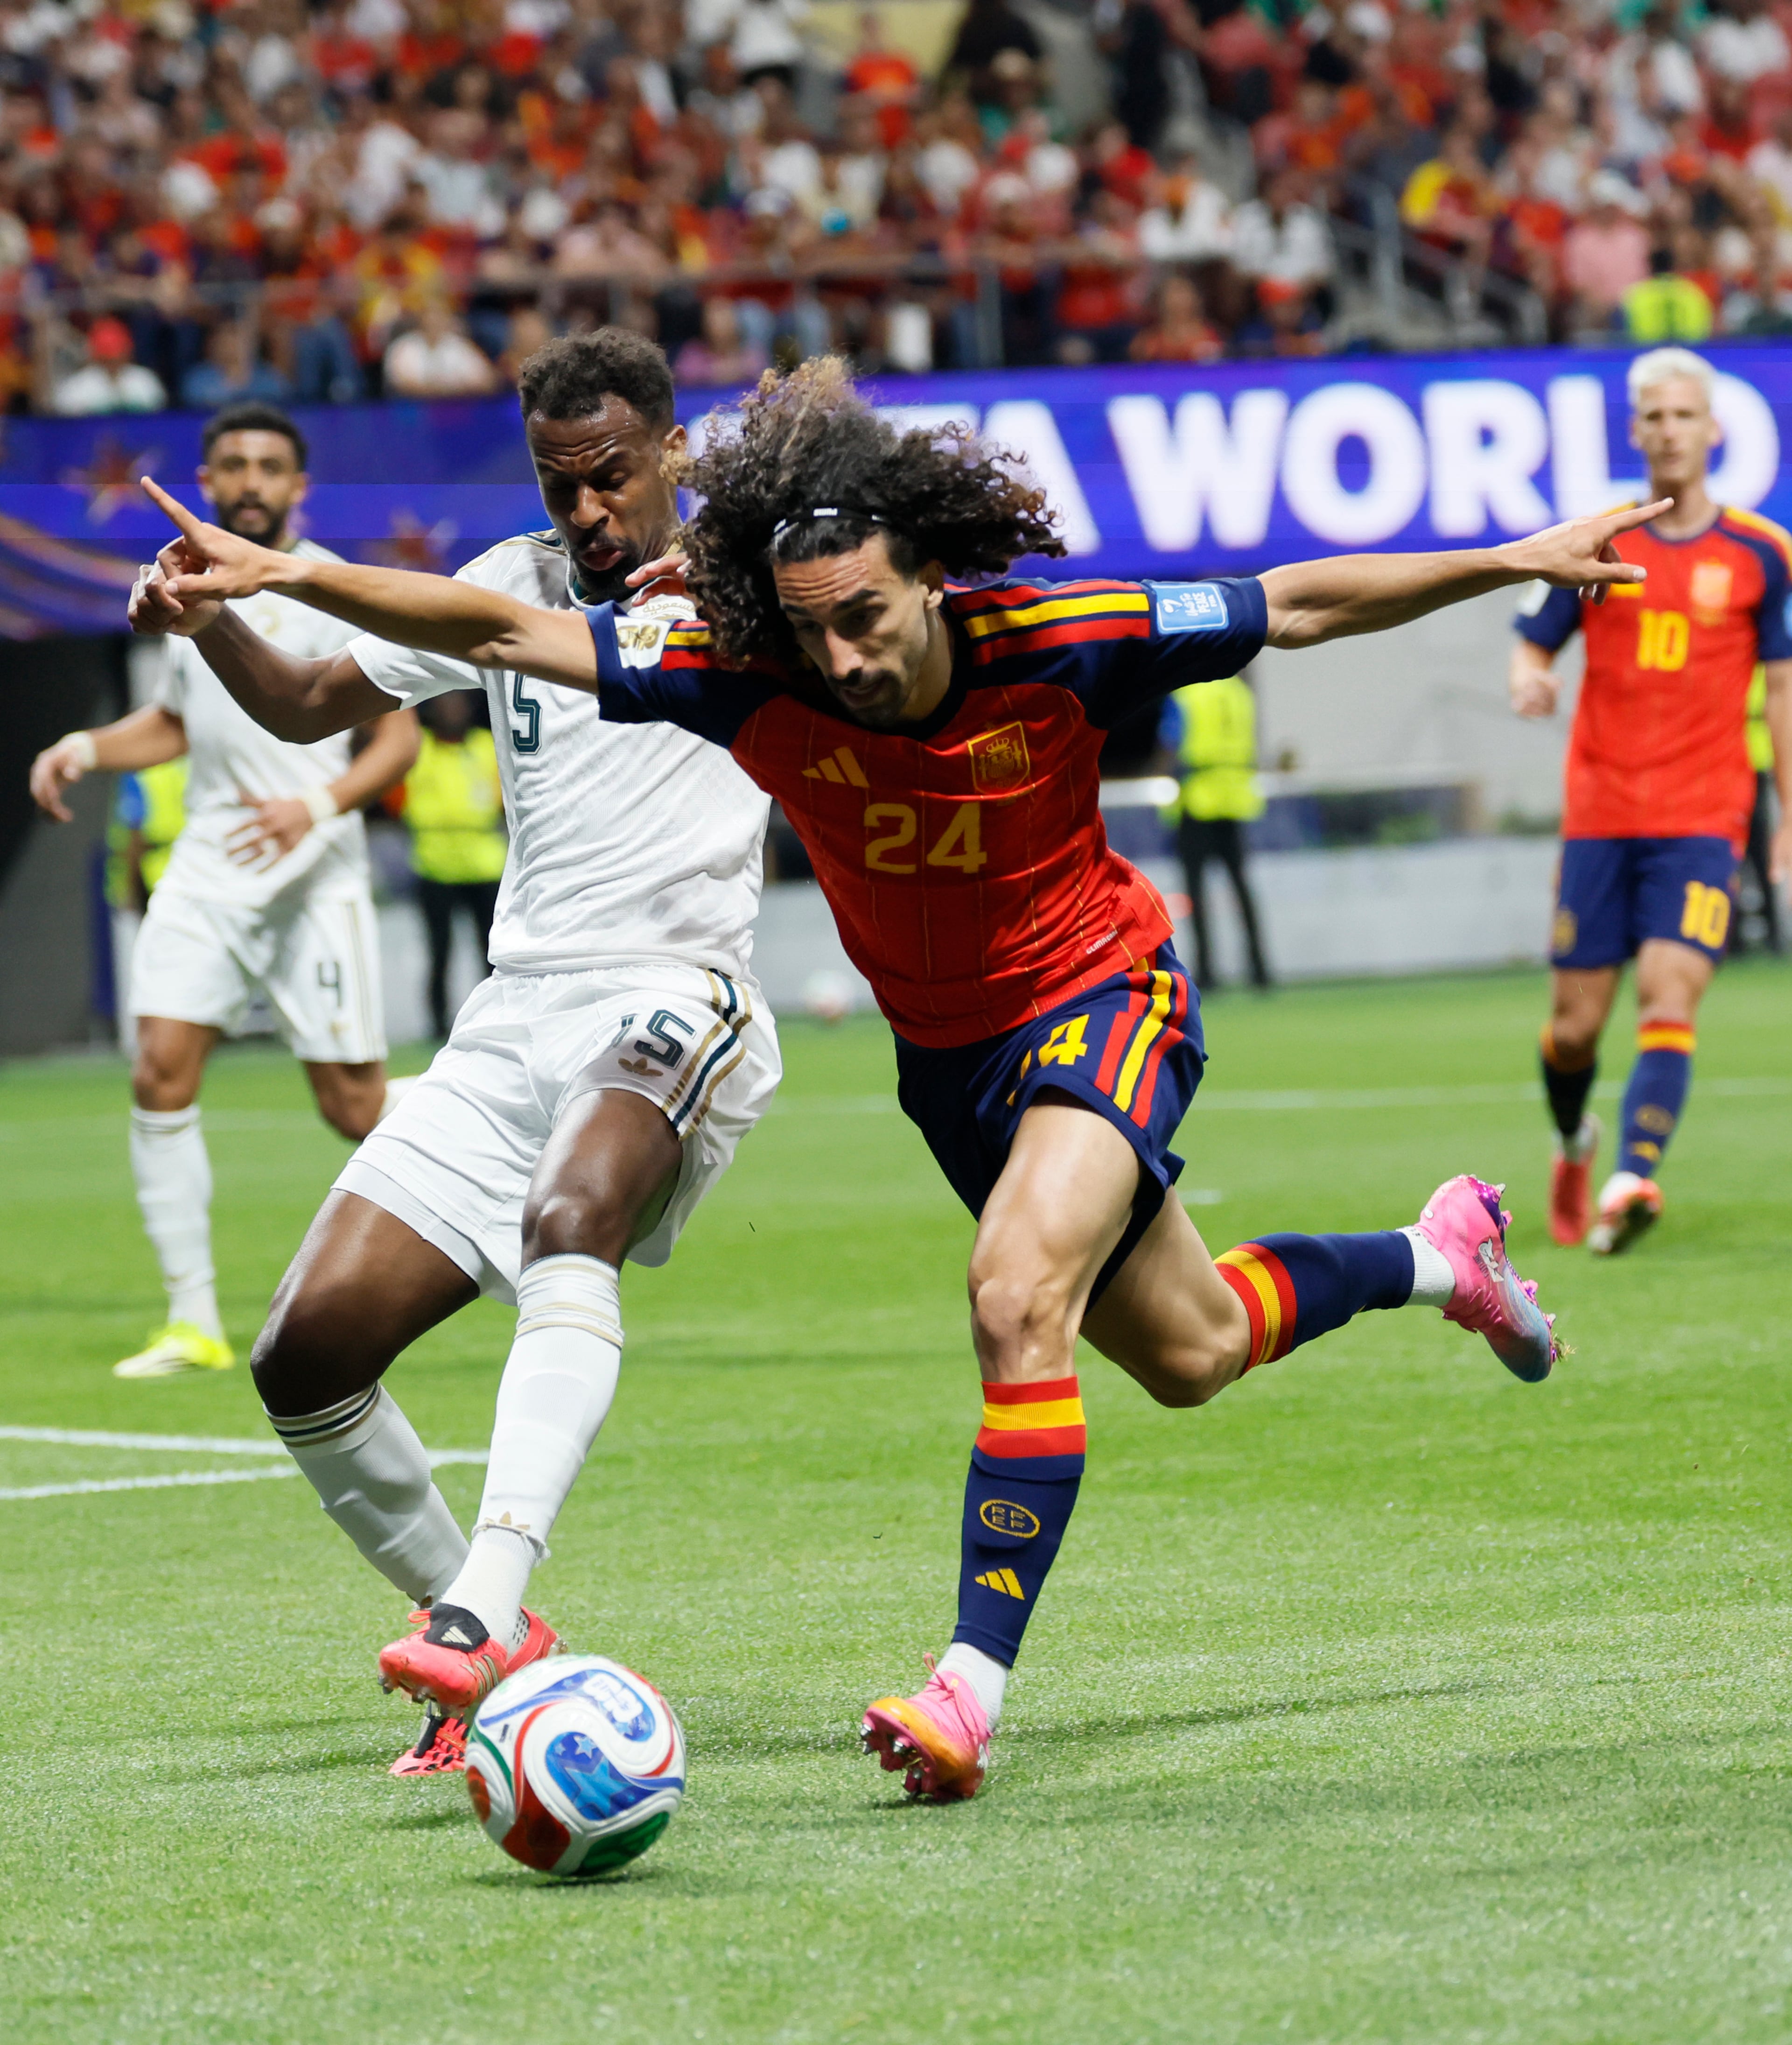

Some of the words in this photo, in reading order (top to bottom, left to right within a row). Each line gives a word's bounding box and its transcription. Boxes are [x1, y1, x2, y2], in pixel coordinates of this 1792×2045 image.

[1107, 372, 1779, 552] WORLD
[1637, 608, 1690, 672] 10
[501, 668, 543, 755] 5
[863, 802, 987, 874] 24
[1680, 880, 1731, 949] 10
[316, 960, 342, 1009] 4
